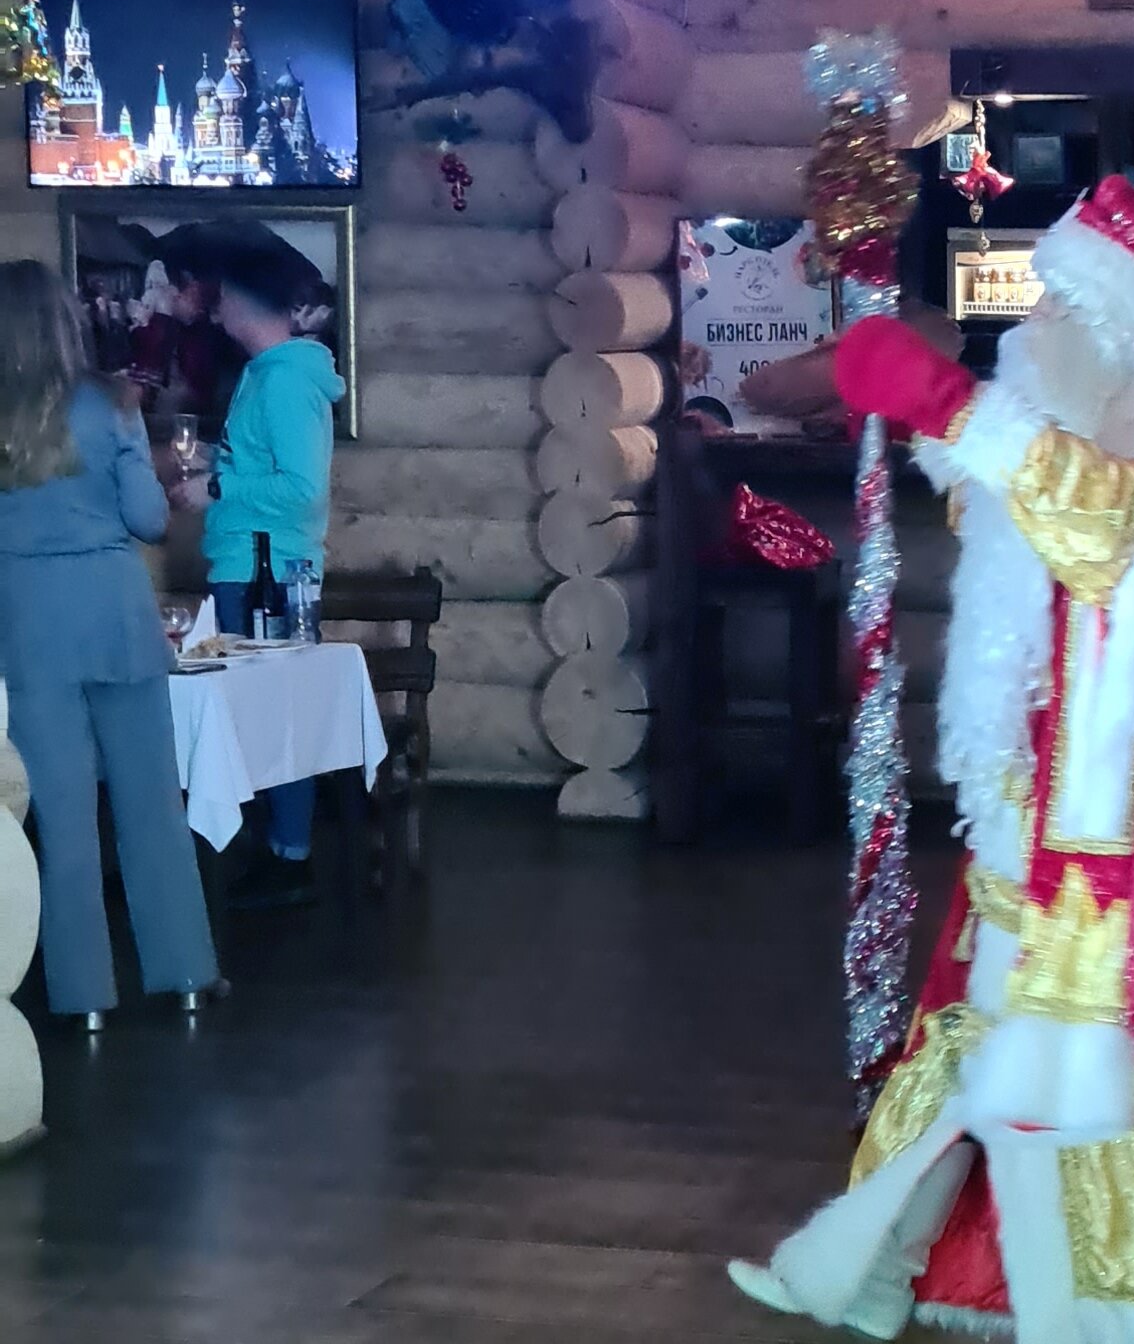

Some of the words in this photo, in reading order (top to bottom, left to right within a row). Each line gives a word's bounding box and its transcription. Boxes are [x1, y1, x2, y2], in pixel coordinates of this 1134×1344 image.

[732, 304, 784, 314] РЕСТОРАН
[707, 323, 763, 342] БИЗНЕС
[768, 322, 808, 341] ЛАНЧ
